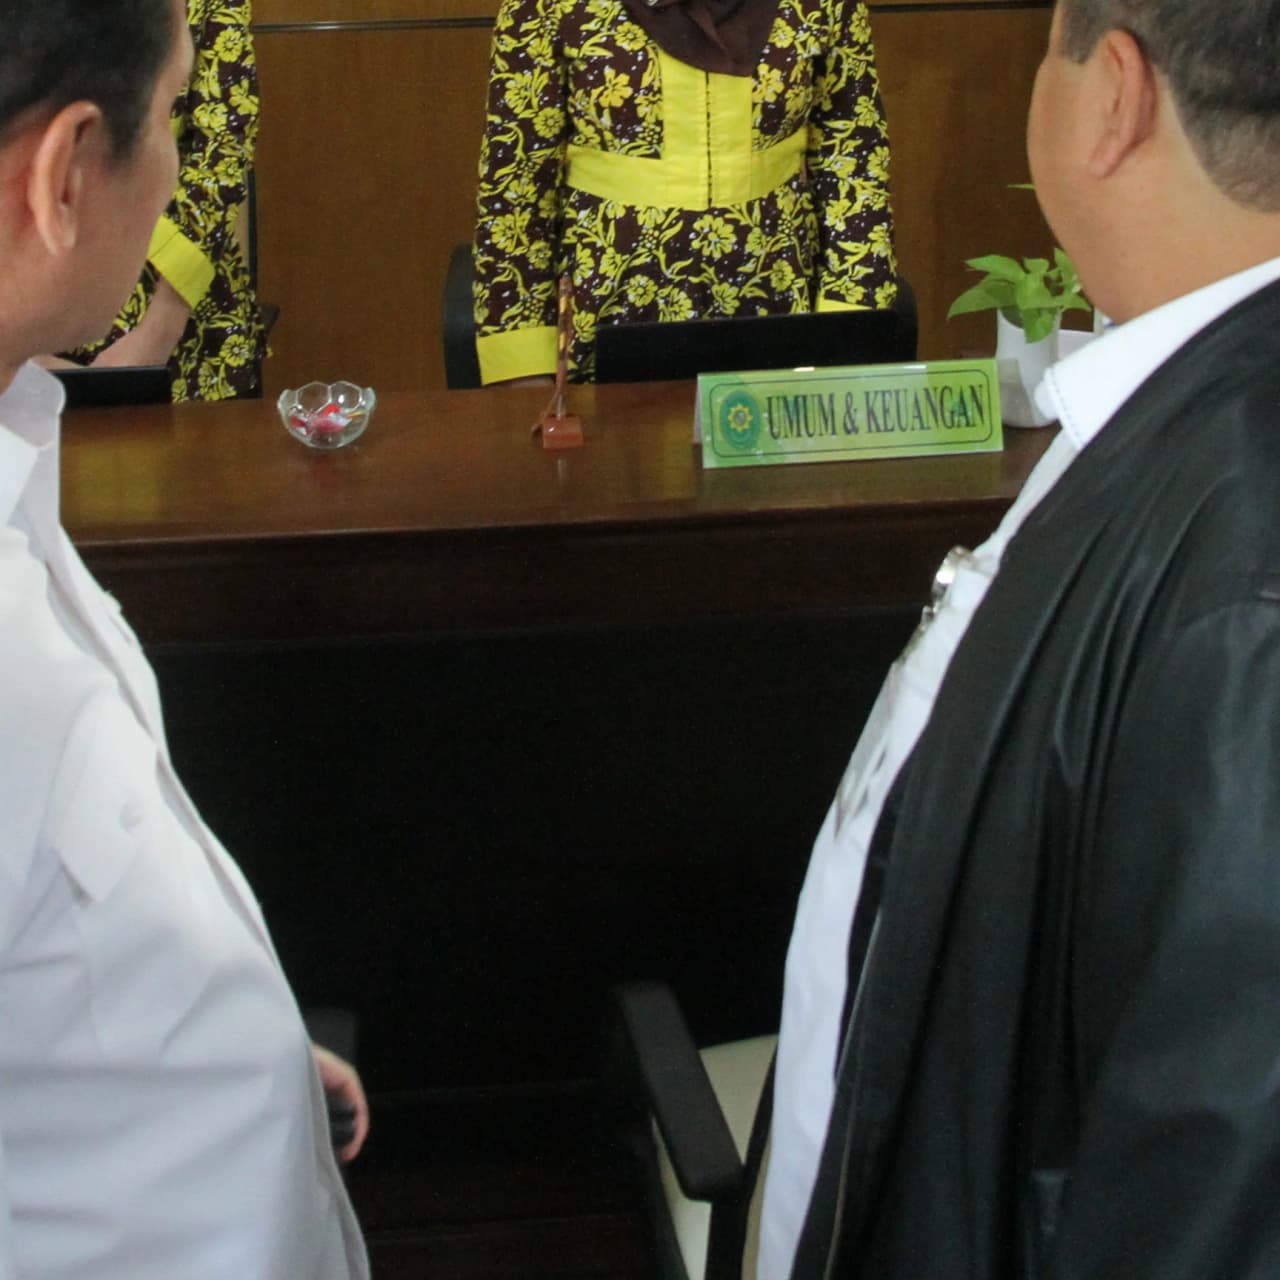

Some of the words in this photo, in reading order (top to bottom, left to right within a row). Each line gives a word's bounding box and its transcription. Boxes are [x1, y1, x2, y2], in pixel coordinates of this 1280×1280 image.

[766, 393, 838, 440] UMUM
[844, 392, 859, 435] &
[864, 384, 986, 434] KEUANGAN
